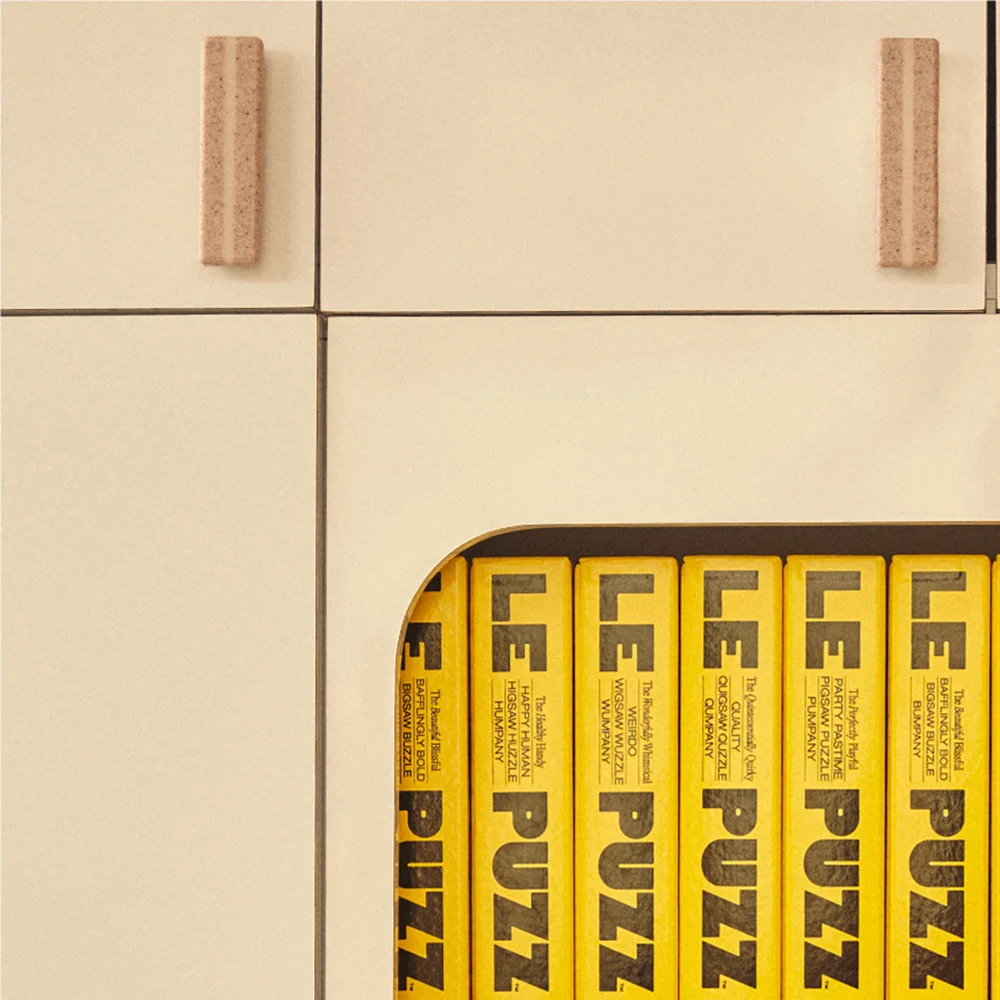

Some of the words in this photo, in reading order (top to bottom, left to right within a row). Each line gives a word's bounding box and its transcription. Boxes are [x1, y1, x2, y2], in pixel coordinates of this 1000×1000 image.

[400, 570, 441, 670] E
[492, 574, 547, 672] LE
[599, 574, 654, 672] LE
[703, 570, 758, 668] LE
[806, 571, 860, 669] LE
[911, 571, 966, 669] LE
[402, 683, 412, 730] BIGSAW
[416, 679, 425, 747] BAFFLINGLY
[431, 690, 441, 706] The
[507, 681, 517, 730] HIGSAW
[521, 686, 530, 727] HAPPY
[614, 677, 624, 730] WIGSAW
[643, 681, 653, 696] The
[718, 676, 728, 731] QUIGSAW
[820, 676, 830, 727] PIGSAW
[834, 679, 843, 720] PARTY
[849, 689, 859, 704] The
[927, 683, 935, 728] BIGSAW
[940, 678, 948, 746] BAFFLINGLY
[954, 689, 964, 705] The
[428, 707, 441, 741] Beautiful
[494, 701, 504, 763] HUMPANY
[601, 699, 610, 764] WUMPANY
[628, 706, 637, 756] WEIRDO
[640, 698, 653, 742] Wonderfully
[705, 698, 714, 758] QUMPANY
[731, 701, 740, 752] QUALITY
[807, 697, 816, 761] PUMPANY
[846, 706, 858, 740] Perfectly
[913, 701, 921, 758] BUMPANY
[952, 706, 964, 740] Beautiful
[402, 732, 412, 777] BUZZLE
[416, 750, 425, 782] BOLD
[431, 743, 441, 771] Blissful
[508, 734, 517, 782] HUZZLE
[521, 731, 530, 777] HUMAN
[614, 733, 623, 784] WUZZLE
[643, 743, 653, 783] Whimsical
[718, 733, 727, 780] QUZZLE
[820, 731, 829, 781] PUZZLE
[834, 724, 843, 779] PASTIME
[846, 743, 859, 770] Playful
[926, 731, 934, 776] BUZZLE
[939, 749, 948, 781] BOLD
[954, 742, 964, 770] Blissful
[398, 790, 443, 991] PUZZ
[493, 792, 549, 992] PUZZ
[599, 792, 654, 992] PUZZ
[701, 789, 757, 989] PUZZ
[804, 789, 859, 989] PUZZ
[909, 790, 965, 990] PUZZ
